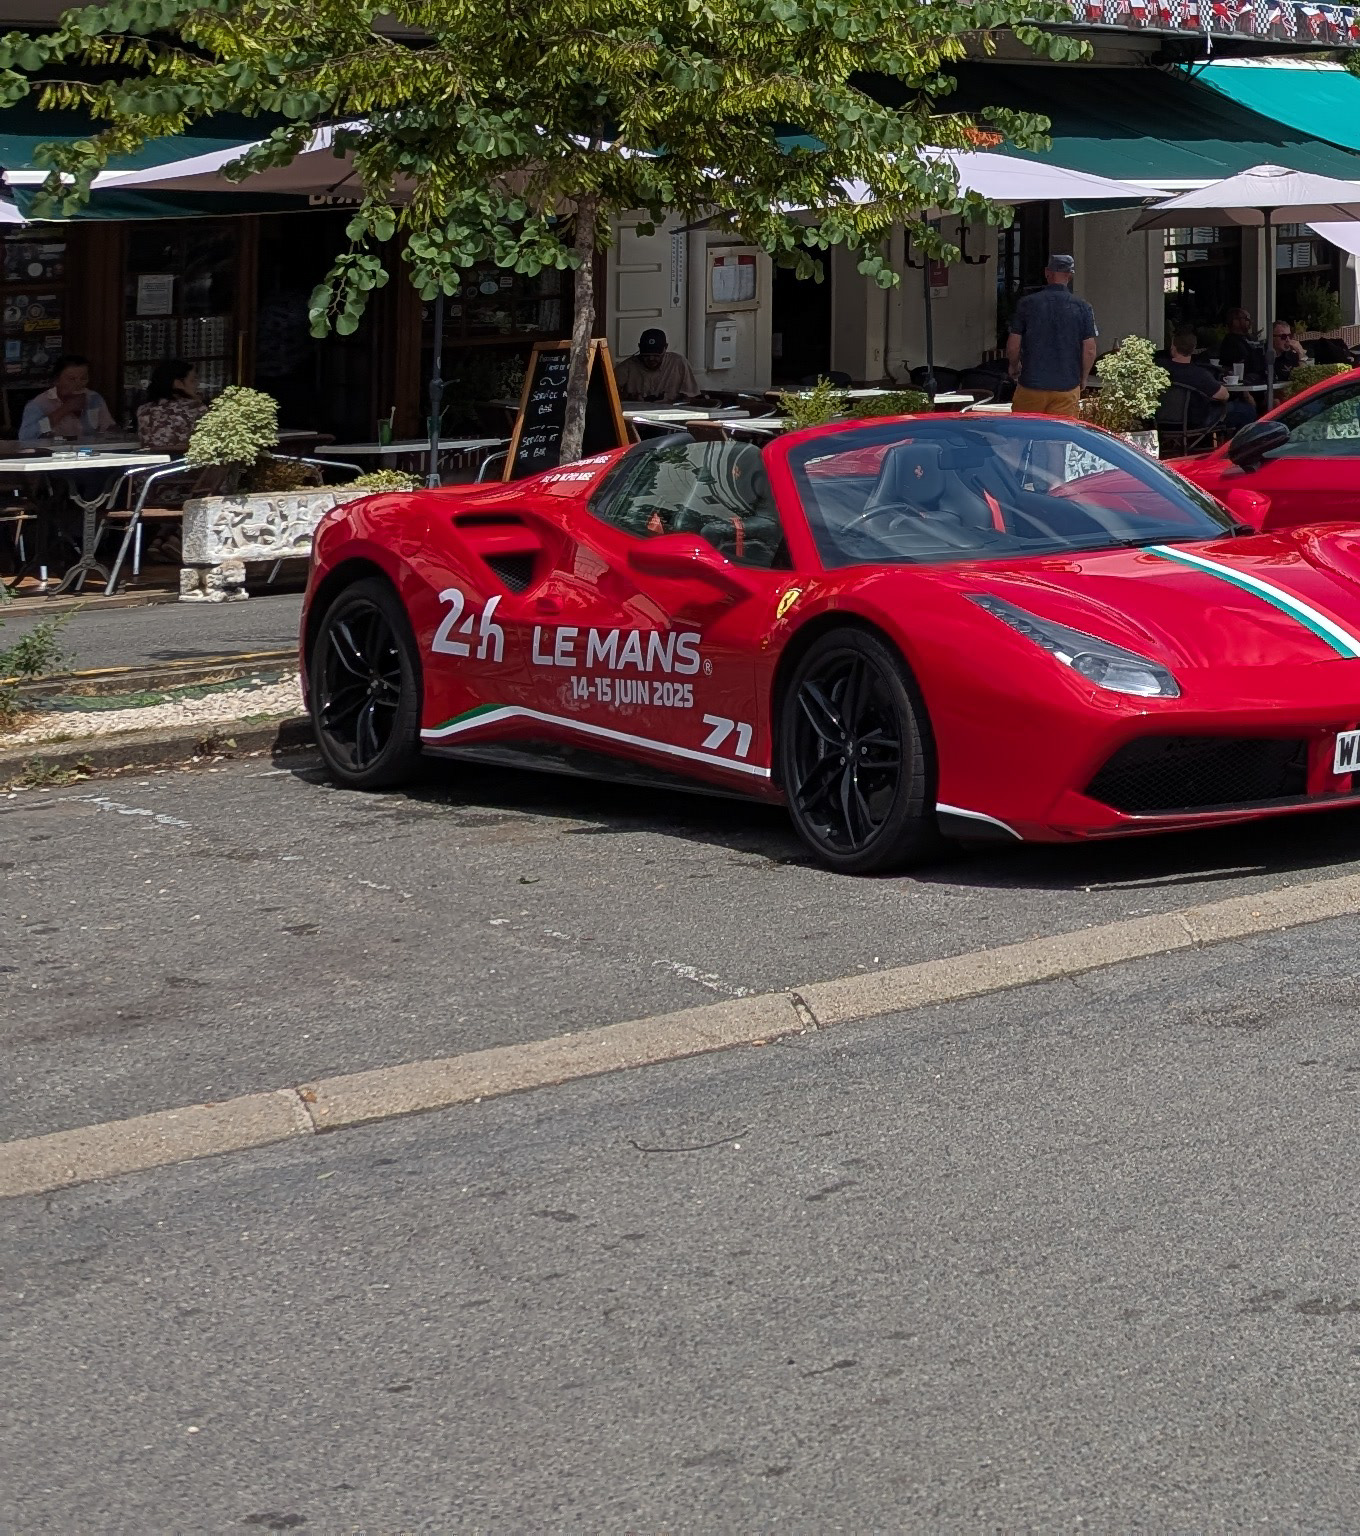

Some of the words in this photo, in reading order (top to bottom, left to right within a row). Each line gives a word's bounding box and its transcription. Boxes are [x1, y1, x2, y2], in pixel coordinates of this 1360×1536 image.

[431, 587, 505, 663] 24h
[532, 625, 577, 666] LE
[586, 628, 701, 675] MANS
[570, 675, 612, 703] 14-15
[614, 678, 649, 707] JUIN
[653, 683, 694, 709] 2025
[701, 712, 753, 757] 71
